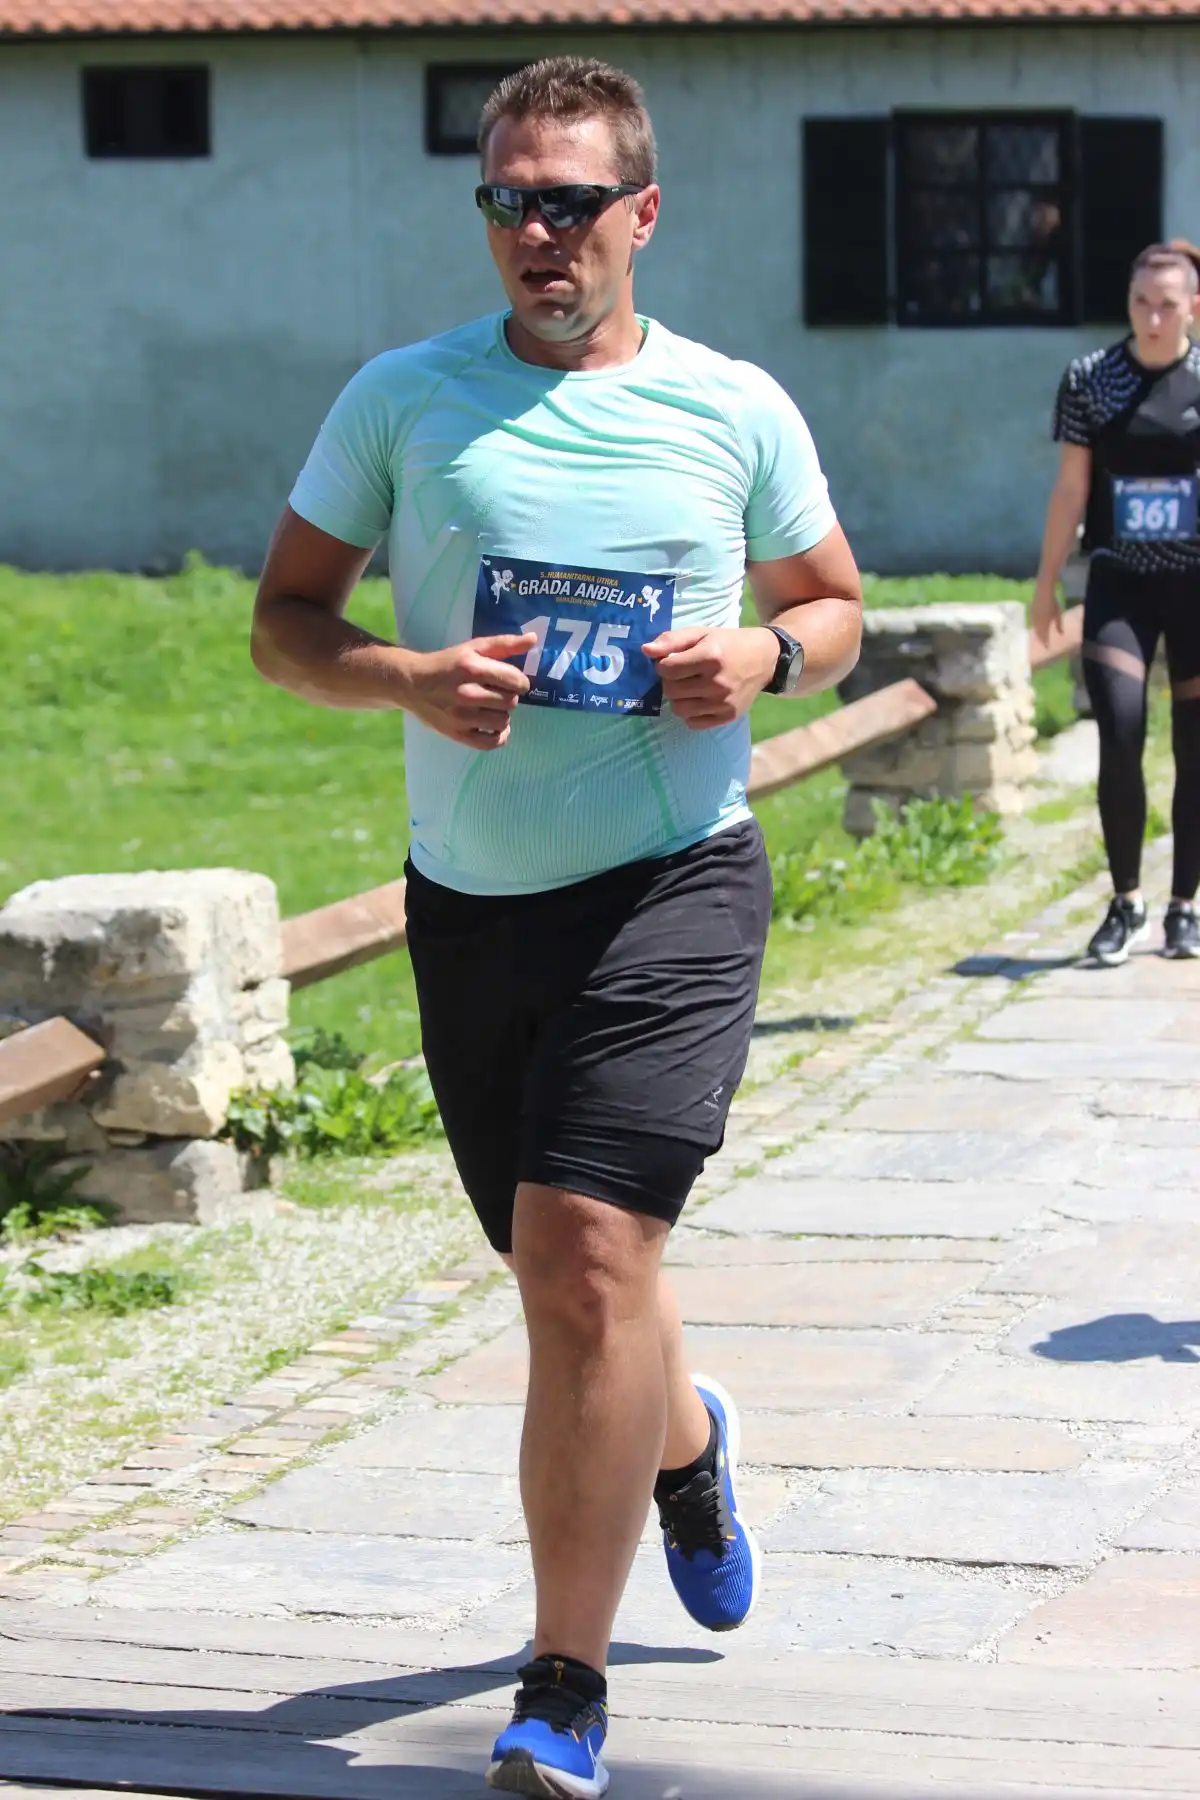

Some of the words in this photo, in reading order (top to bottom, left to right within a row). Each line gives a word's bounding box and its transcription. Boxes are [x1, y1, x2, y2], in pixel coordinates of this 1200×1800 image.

[1125, 497, 1180, 531] 361
[547, 571, 595, 582] HUMANITARNA
[518, 579, 571, 596] GRADA
[574, 582, 637, 608] ANĐELA
[519, 615, 630, 685] 175
